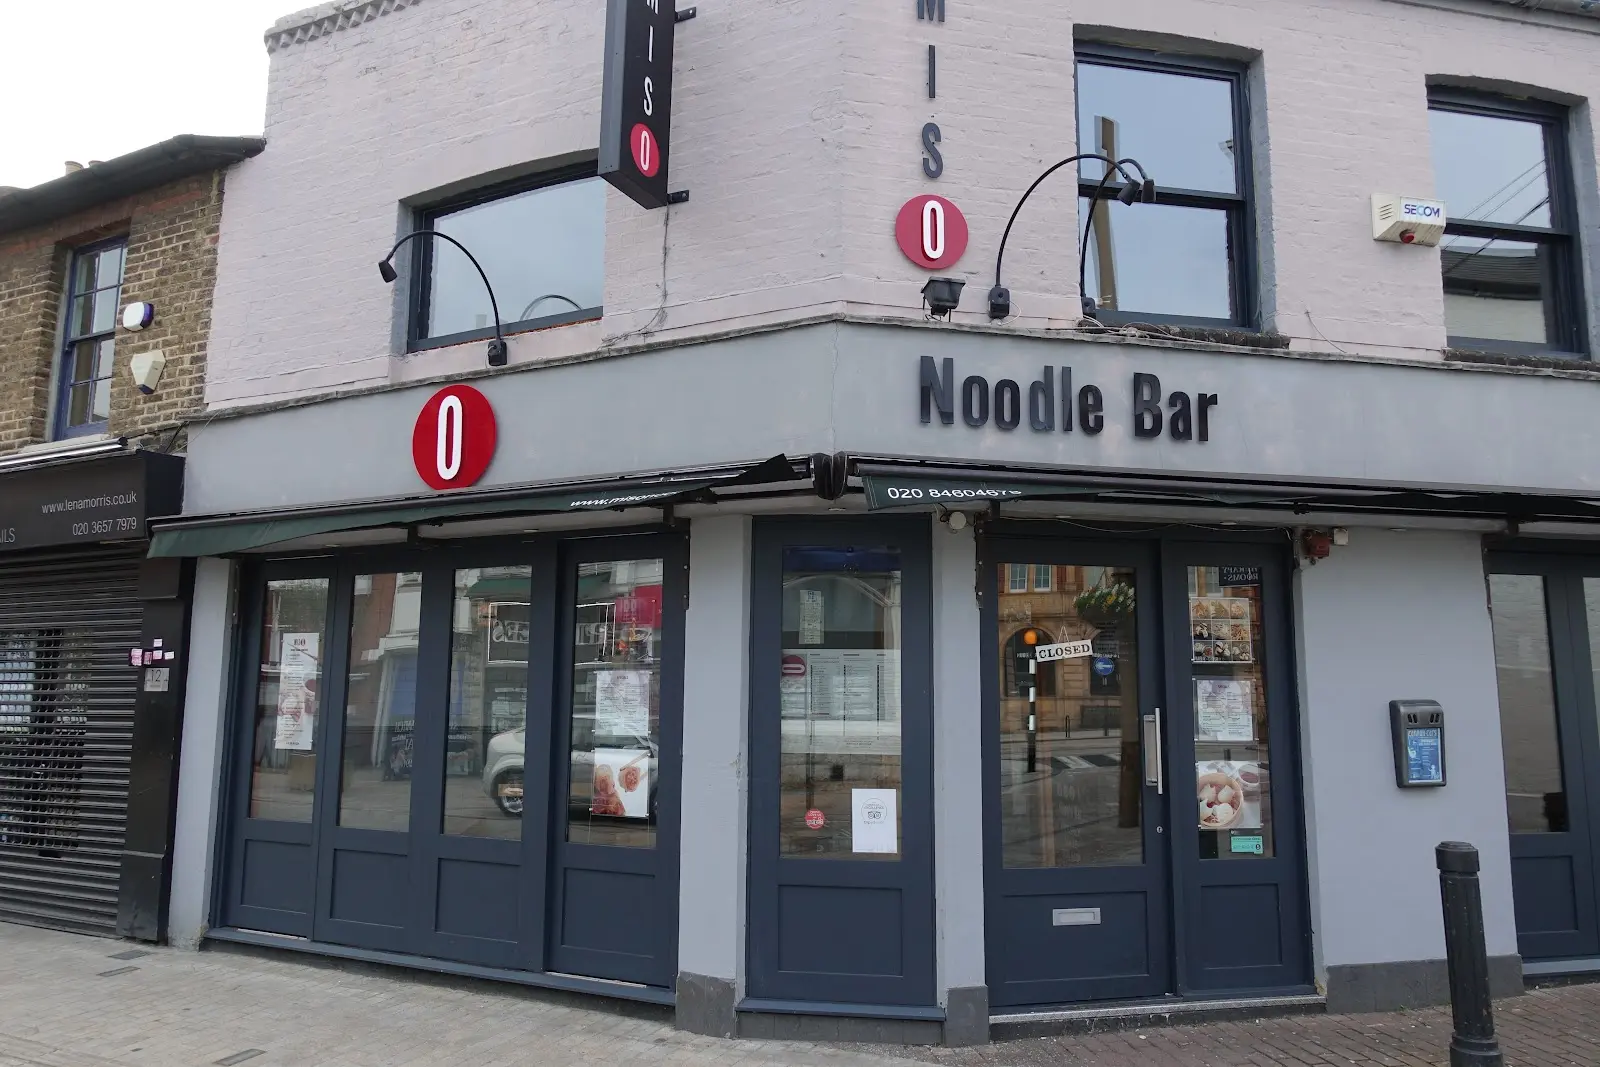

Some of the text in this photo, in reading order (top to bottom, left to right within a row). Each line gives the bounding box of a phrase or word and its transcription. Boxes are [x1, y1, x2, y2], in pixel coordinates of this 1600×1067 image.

[1404, 203, 1440, 218] SECOM
[920, 355, 1218, 442] Noodle Bar
[887, 487, 923, 499] 020
[42, 491, 137, 513] www.lenamorris.co.uk
[72, 517, 137, 535] 020 3657 7979
[1039, 643, 1090, 659] CLOSED
